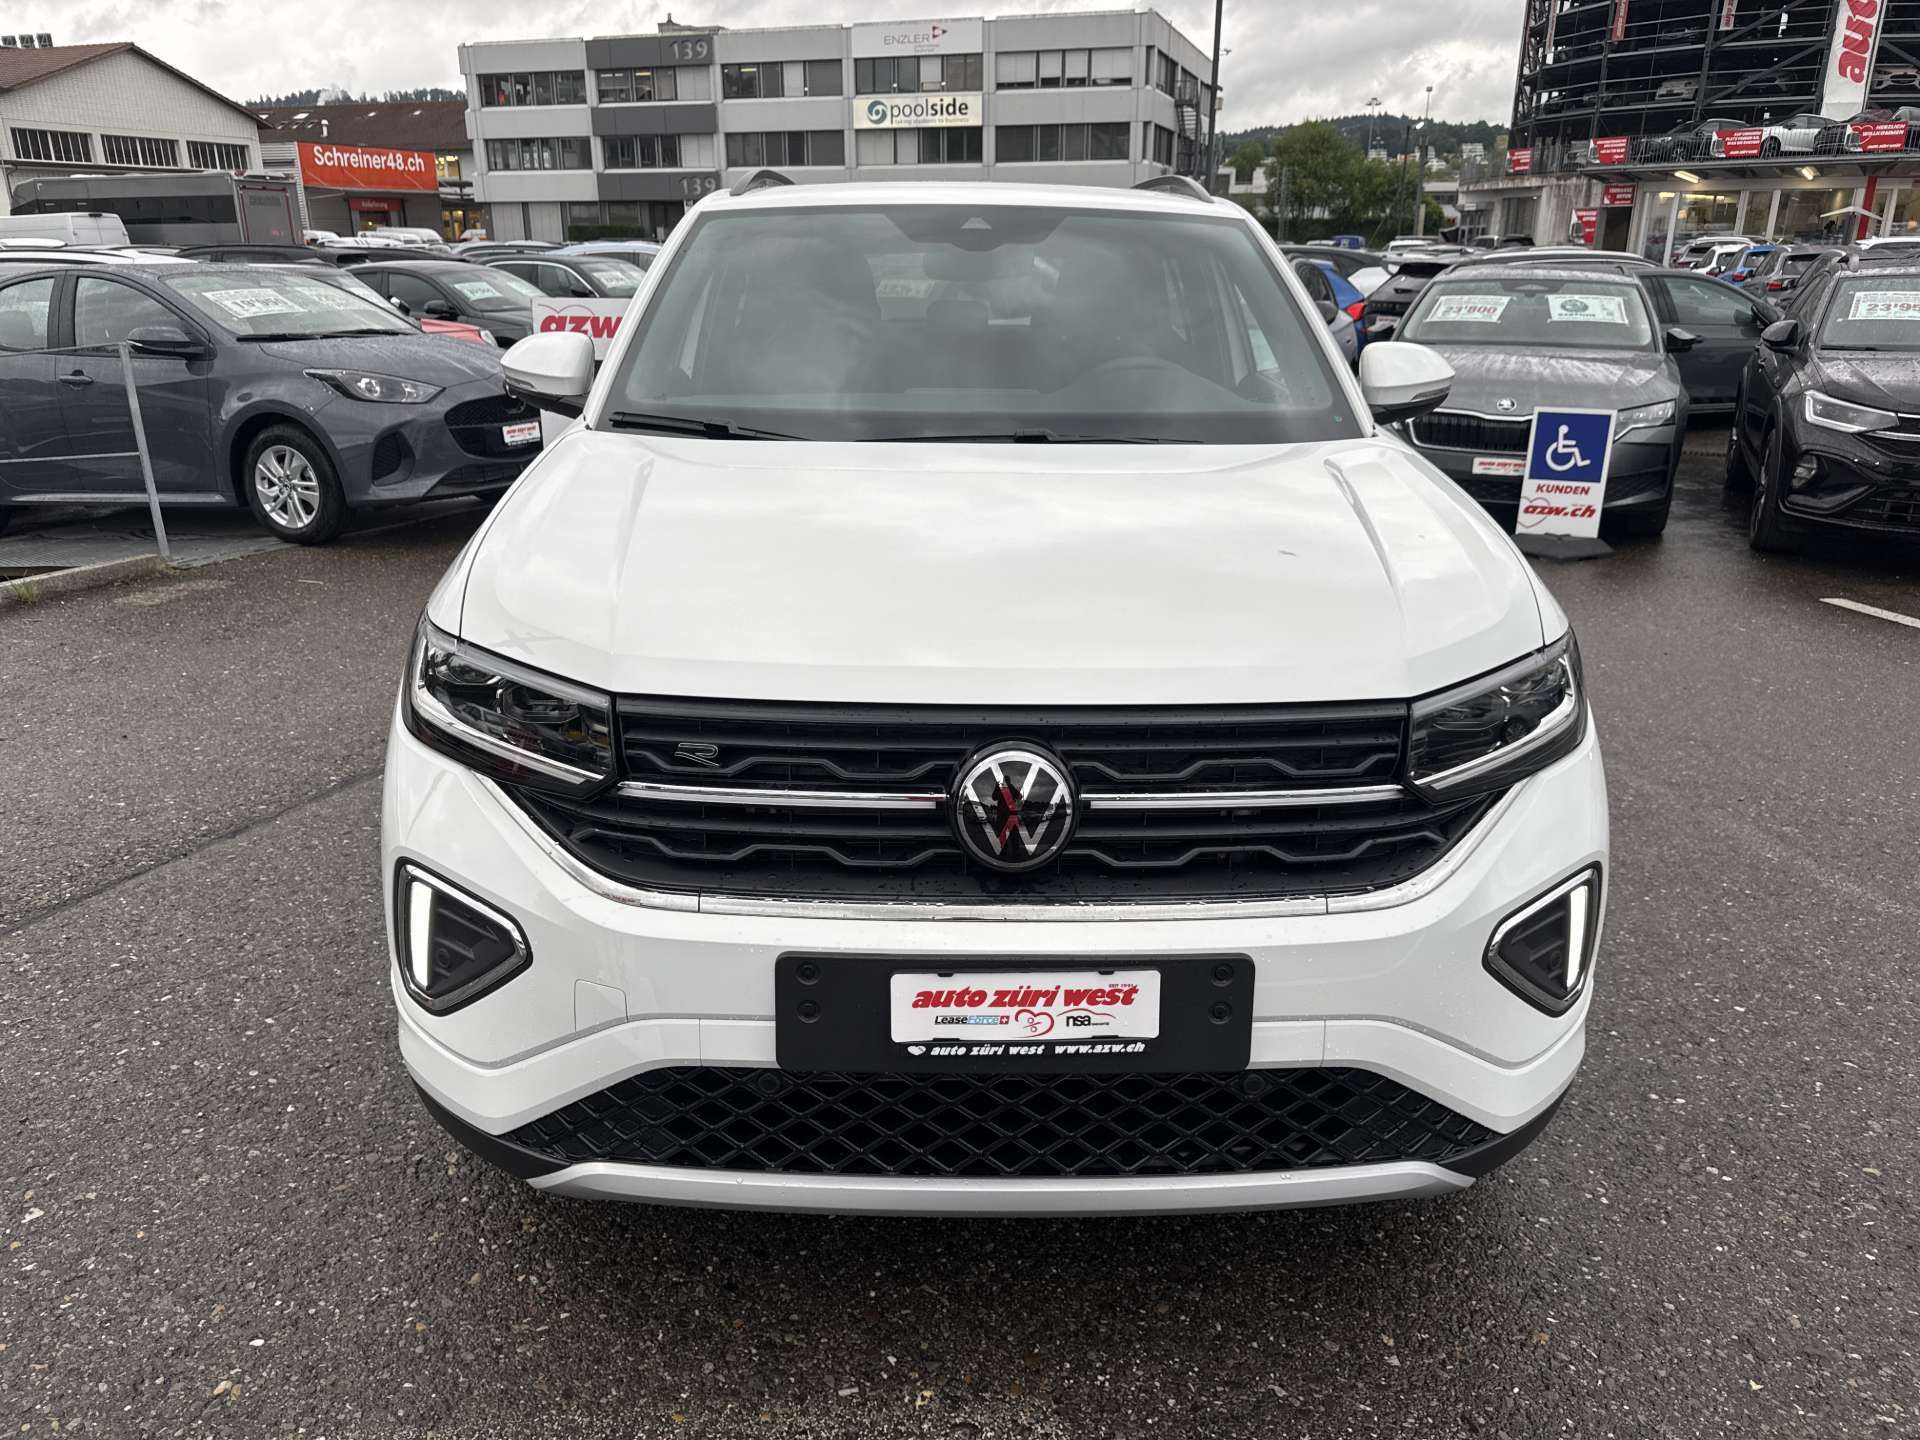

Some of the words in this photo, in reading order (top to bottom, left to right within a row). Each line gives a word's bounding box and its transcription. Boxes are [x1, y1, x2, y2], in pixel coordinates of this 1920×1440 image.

[883, 33, 930, 46] ENZLER
[670, 39, 708, 60] 139
[890, 97, 969, 125] poolside
[313, 145, 425, 172] Schreiner48.ch
[679, 176, 716, 196] 139
[1535, 483, 1591, 496] KUNDEN
[1523, 504, 1596, 518] azw.ch
[911, 986, 987, 1009] auto
[988, 984, 1061, 1008] züri
[1063, 984, 1139, 1007] west
[934, 1015, 998, 1025] LeaseForce
[1066, 1015, 1091, 1027] nsa
[930, 1044, 967, 1055] auto
[970, 1043, 1004, 1055] züri
[1008, 1044, 1045, 1055] west
[1054, 1042, 1146, 1054] www.azw.ch
